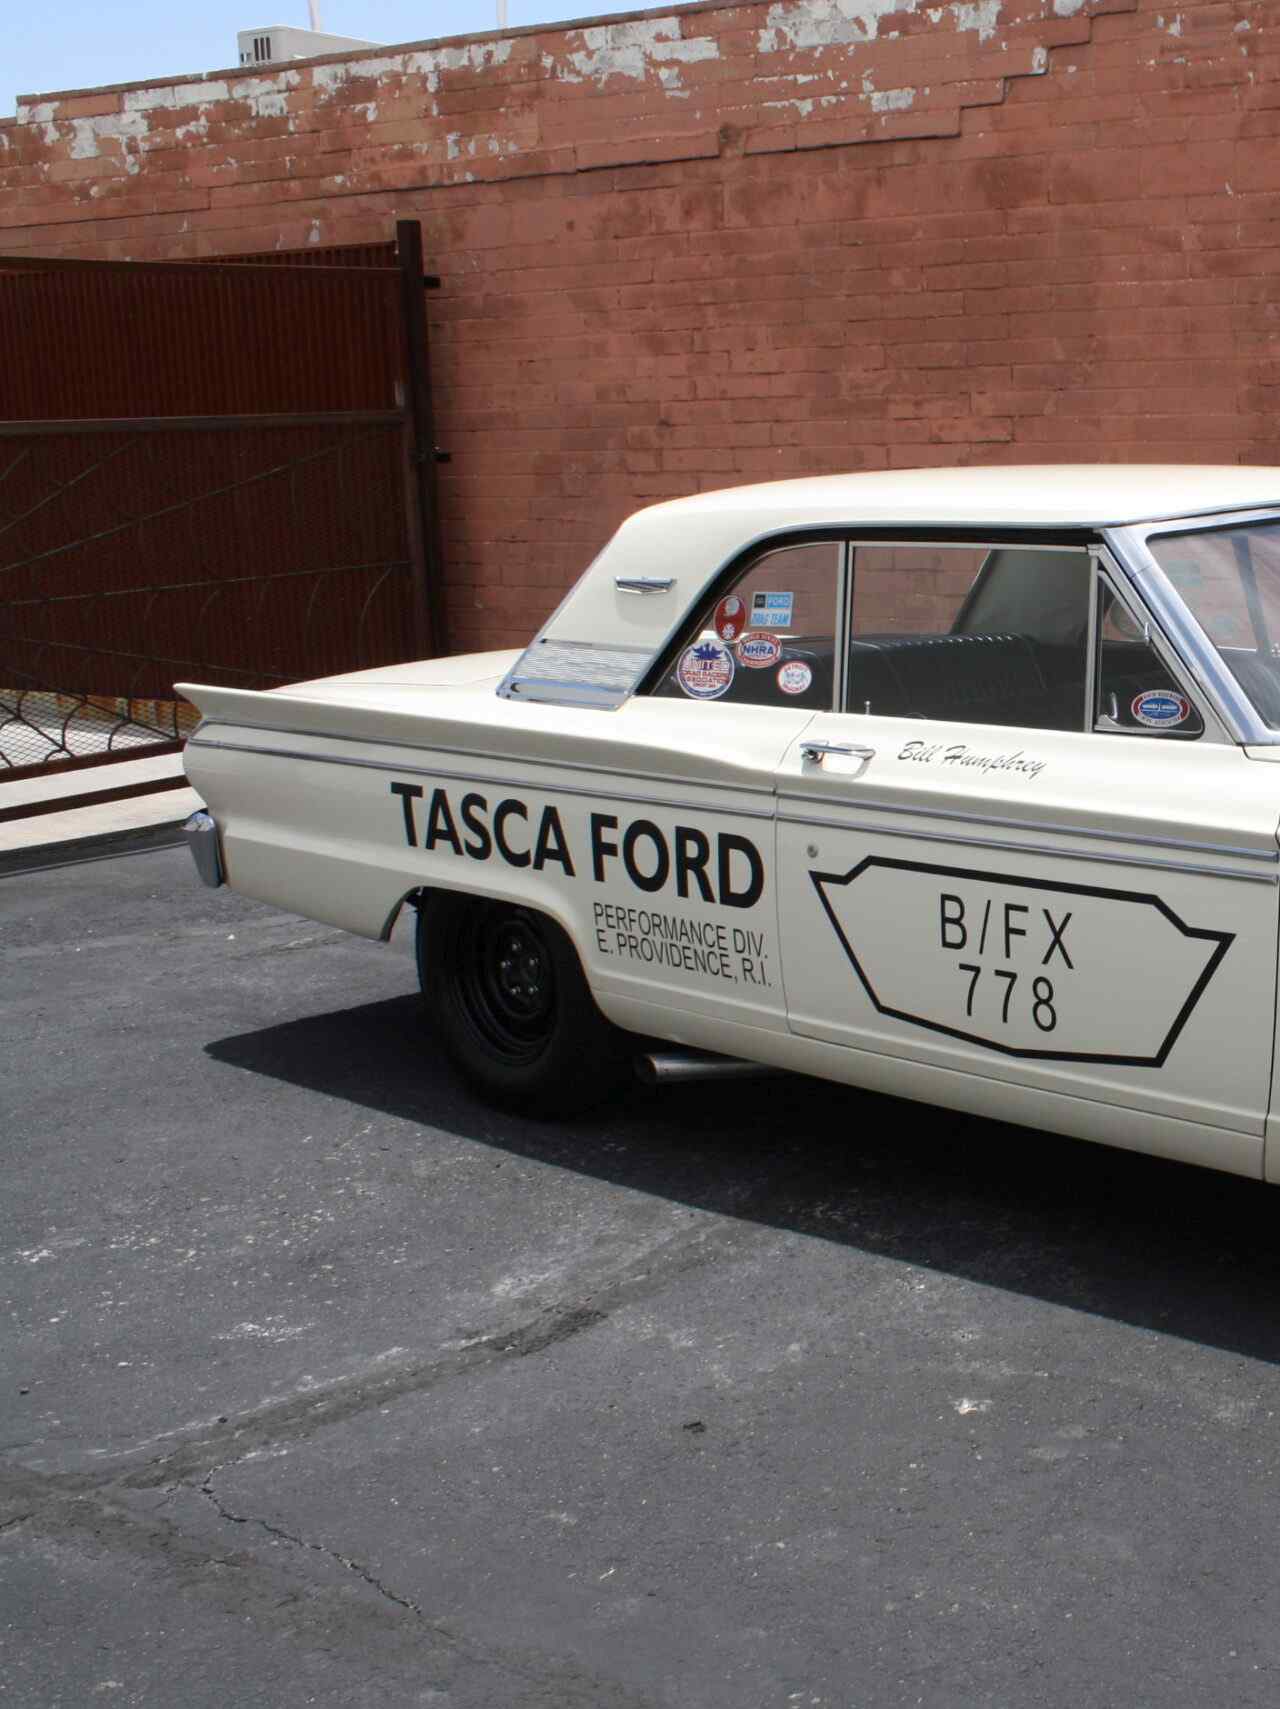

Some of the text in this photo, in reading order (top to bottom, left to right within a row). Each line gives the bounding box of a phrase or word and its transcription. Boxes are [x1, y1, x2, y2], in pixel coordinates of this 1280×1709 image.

[743, 646, 774, 655] NHRA
[897, 741, 1047, 780] Bill Humphrey
[391, 782, 764, 908] TASCA FORD
[593, 902, 769, 959] PERFORMANCE DIV.
[596, 929, 772, 987] E. PROVIDENCE, R.I.
[940, 893, 1074, 970] B/FX
[958, 963, 1057, 1033] 778
